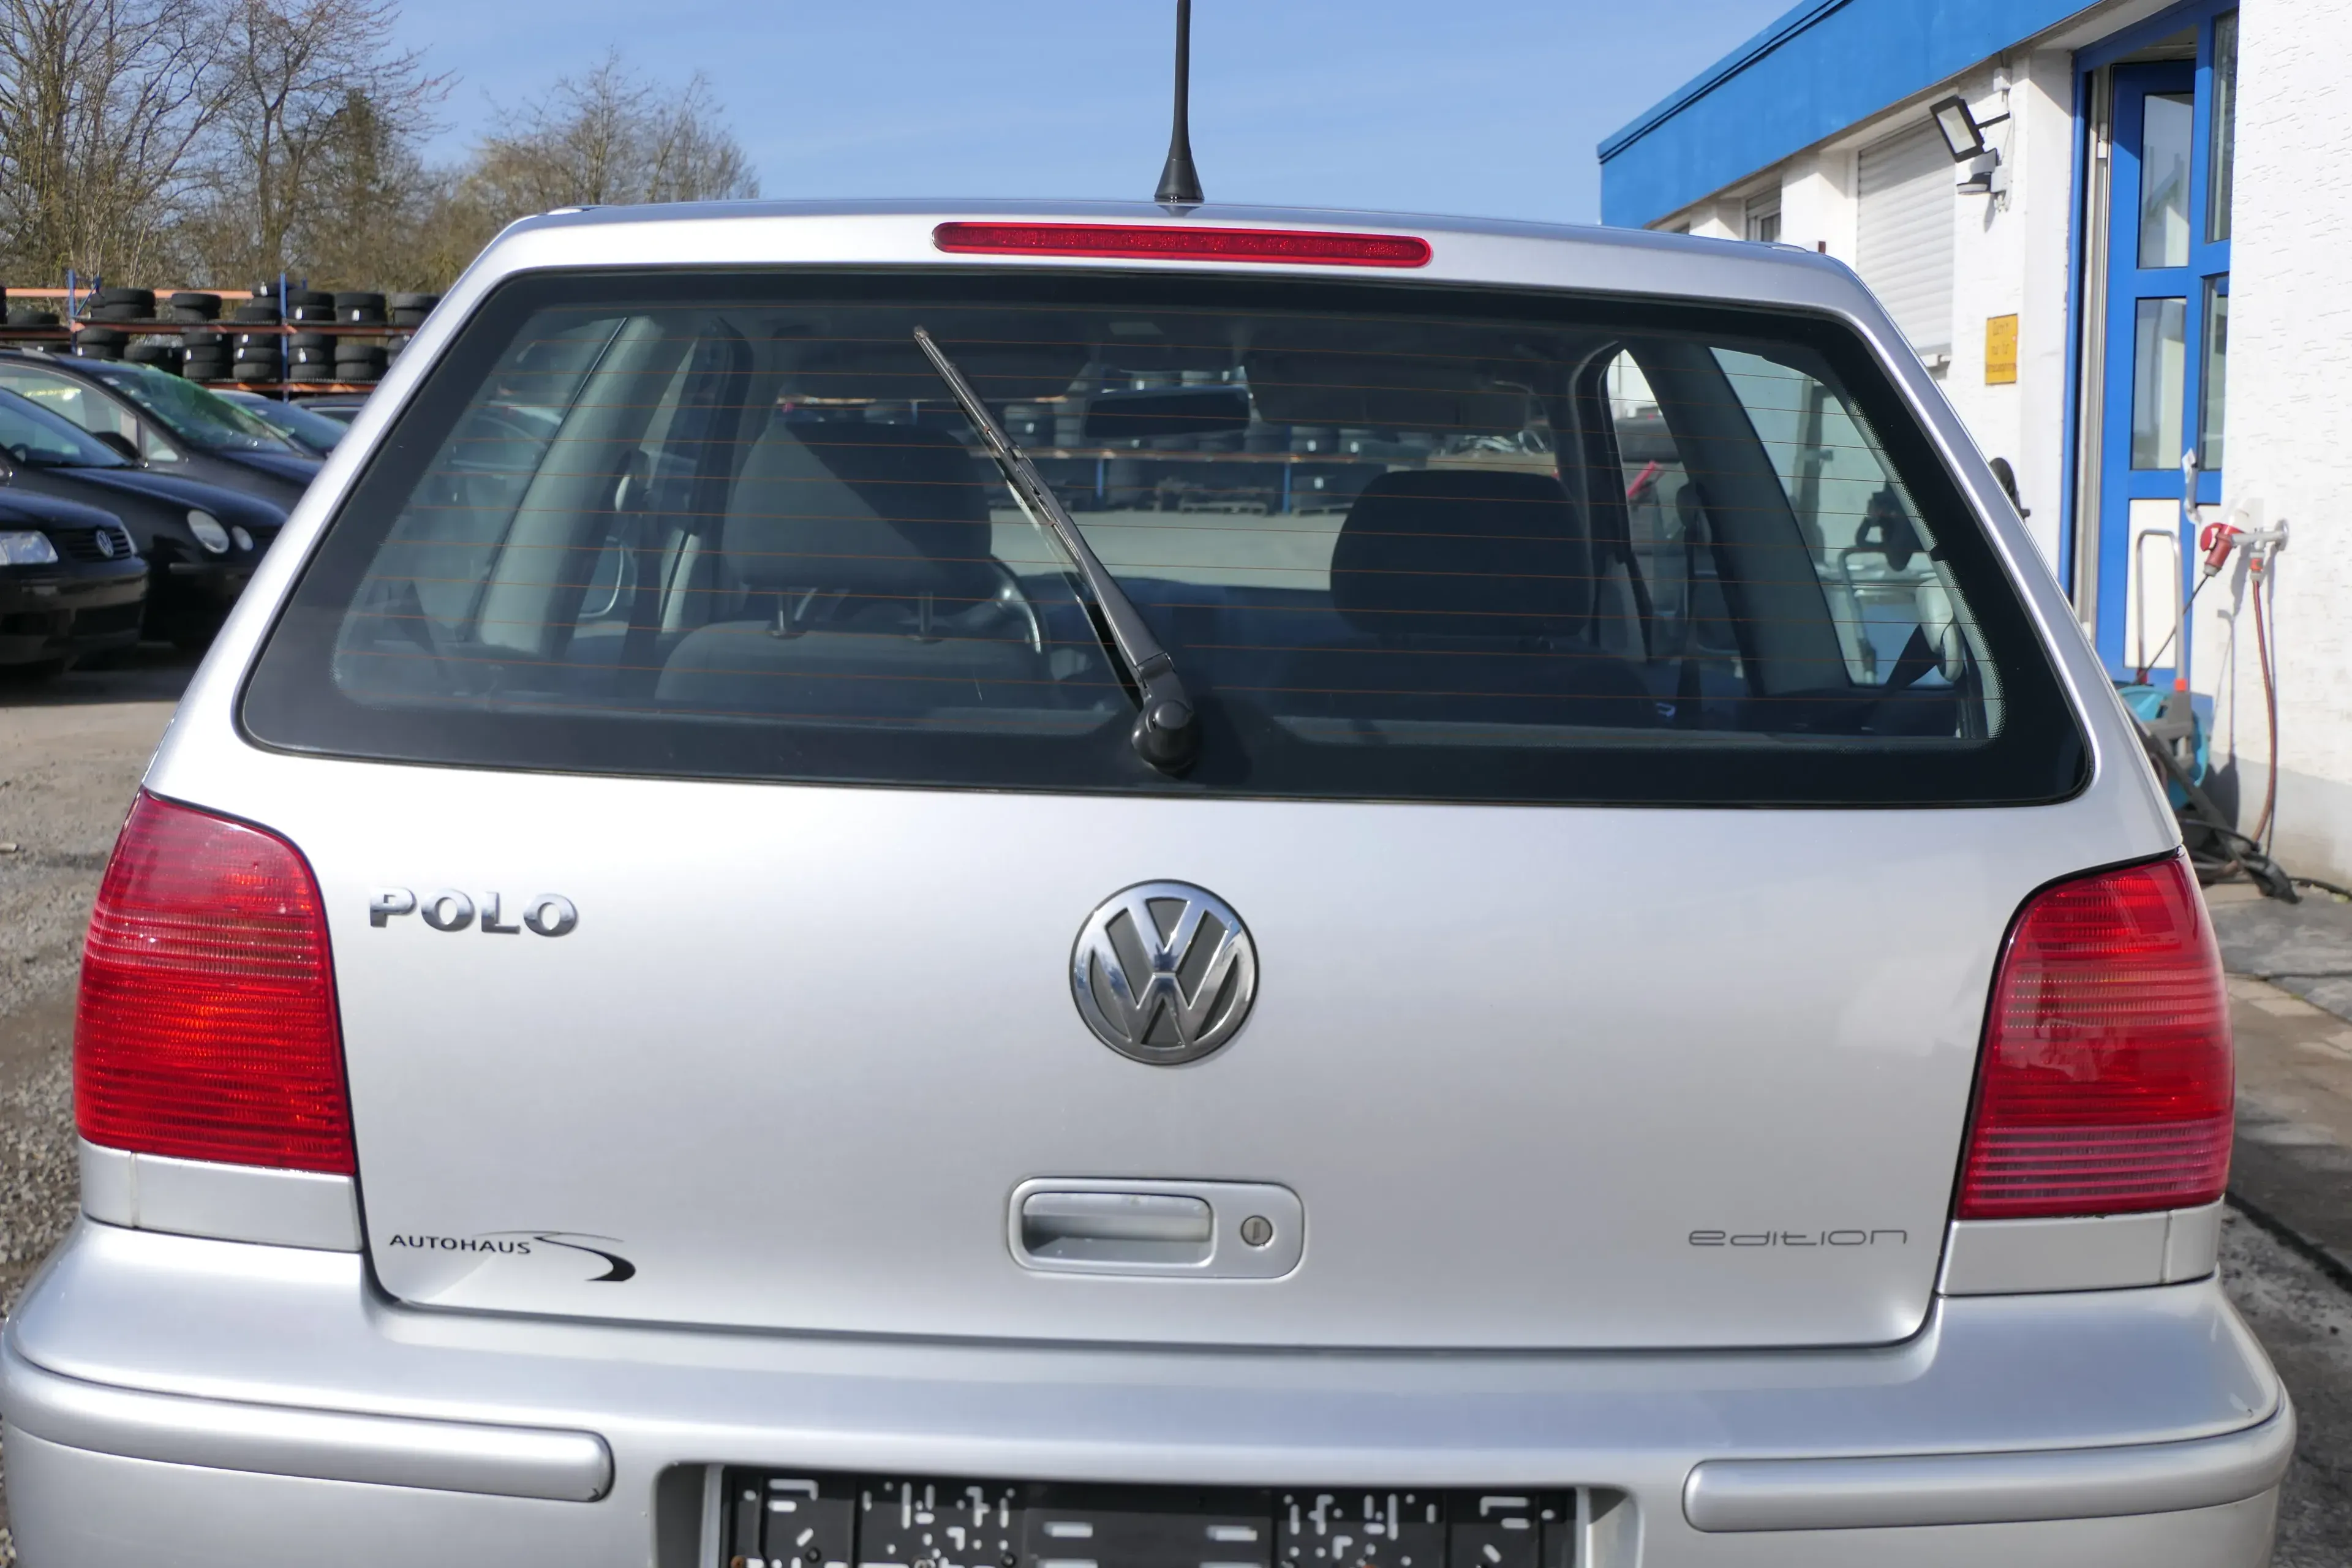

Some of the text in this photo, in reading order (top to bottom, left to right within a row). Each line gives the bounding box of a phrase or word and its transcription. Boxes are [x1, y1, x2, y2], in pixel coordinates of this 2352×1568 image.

[369, 887, 579, 938] POLO
[389, 1234, 532, 1255] AUTOHAUS
[1688, 1229, 1907, 1246] edition
